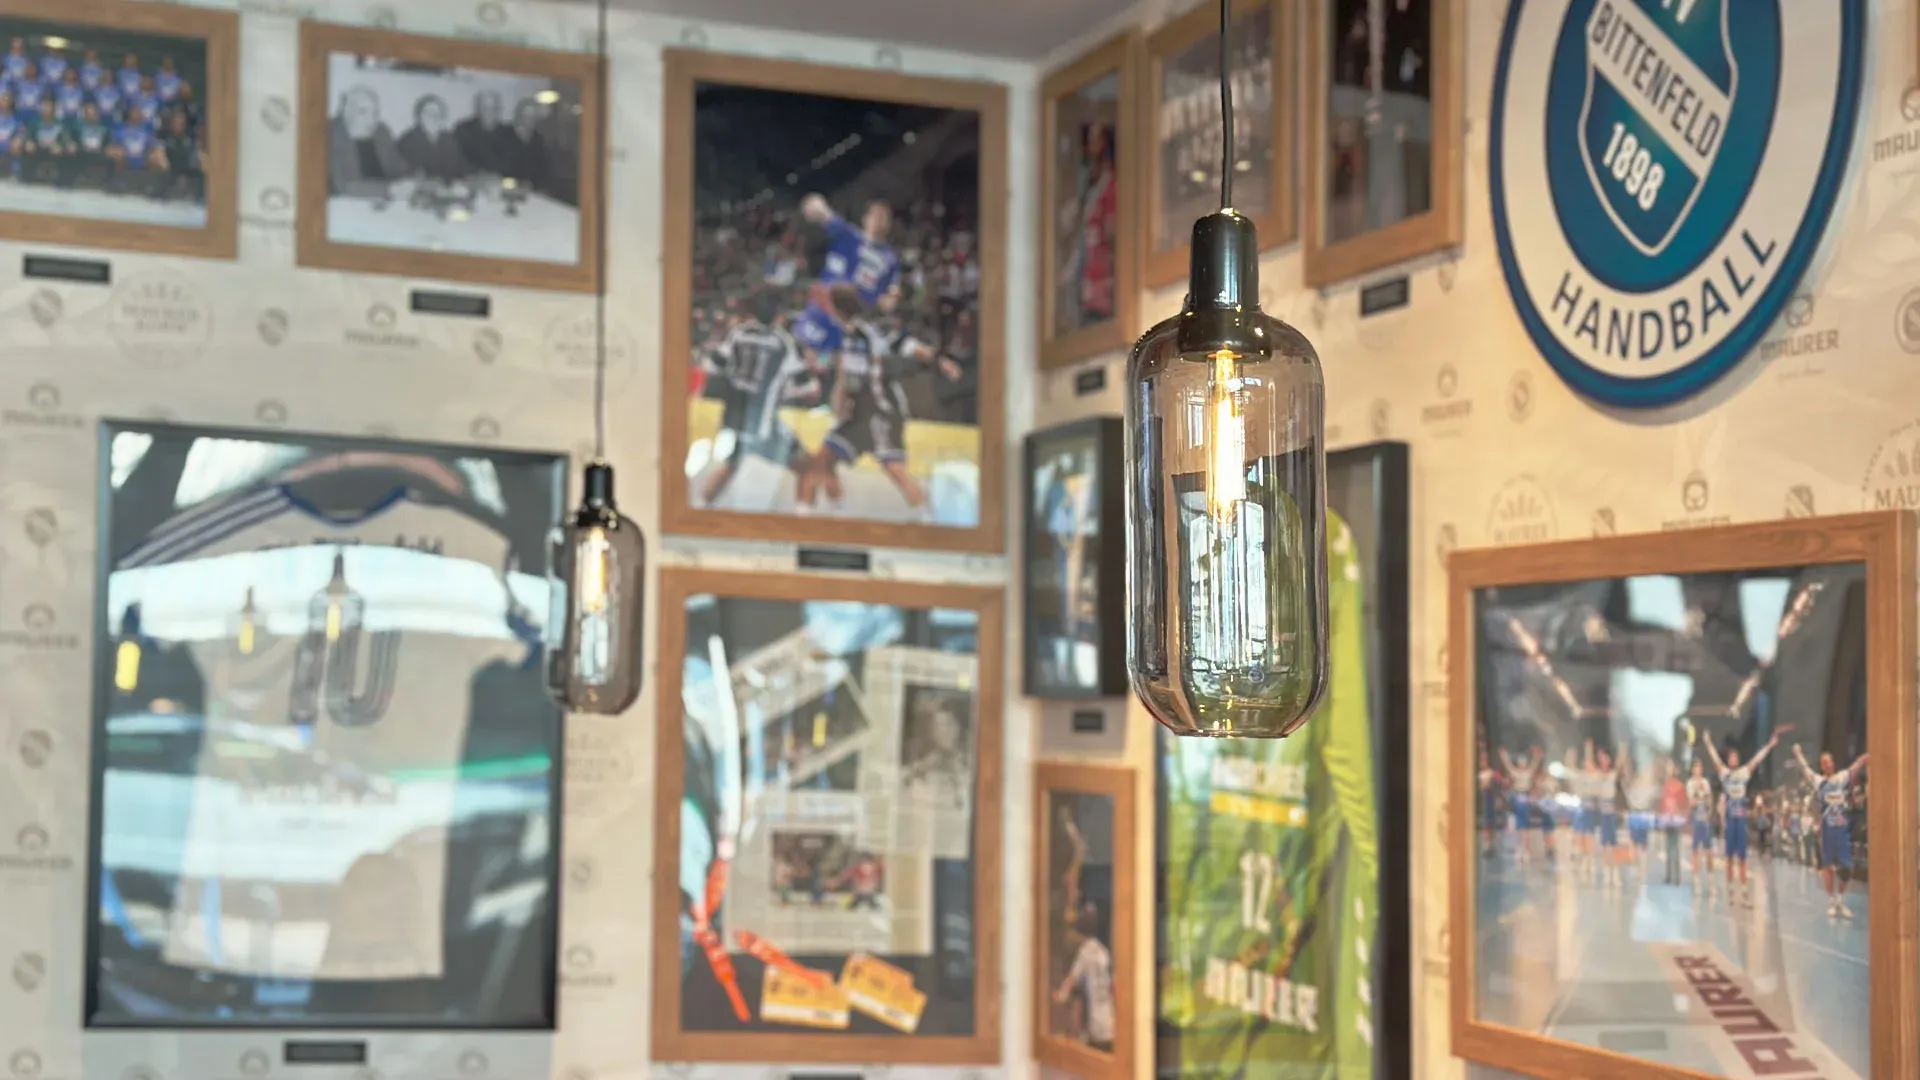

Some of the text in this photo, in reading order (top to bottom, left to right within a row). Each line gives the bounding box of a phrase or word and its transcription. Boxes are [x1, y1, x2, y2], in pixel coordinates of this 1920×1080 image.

[1592, 2, 1720, 158] BITTENFELD
[1602, 121, 1665, 211] 1898
[1551, 229, 1776, 361] HANDBALL
[1673, 955, 1819, 1080] AURER
